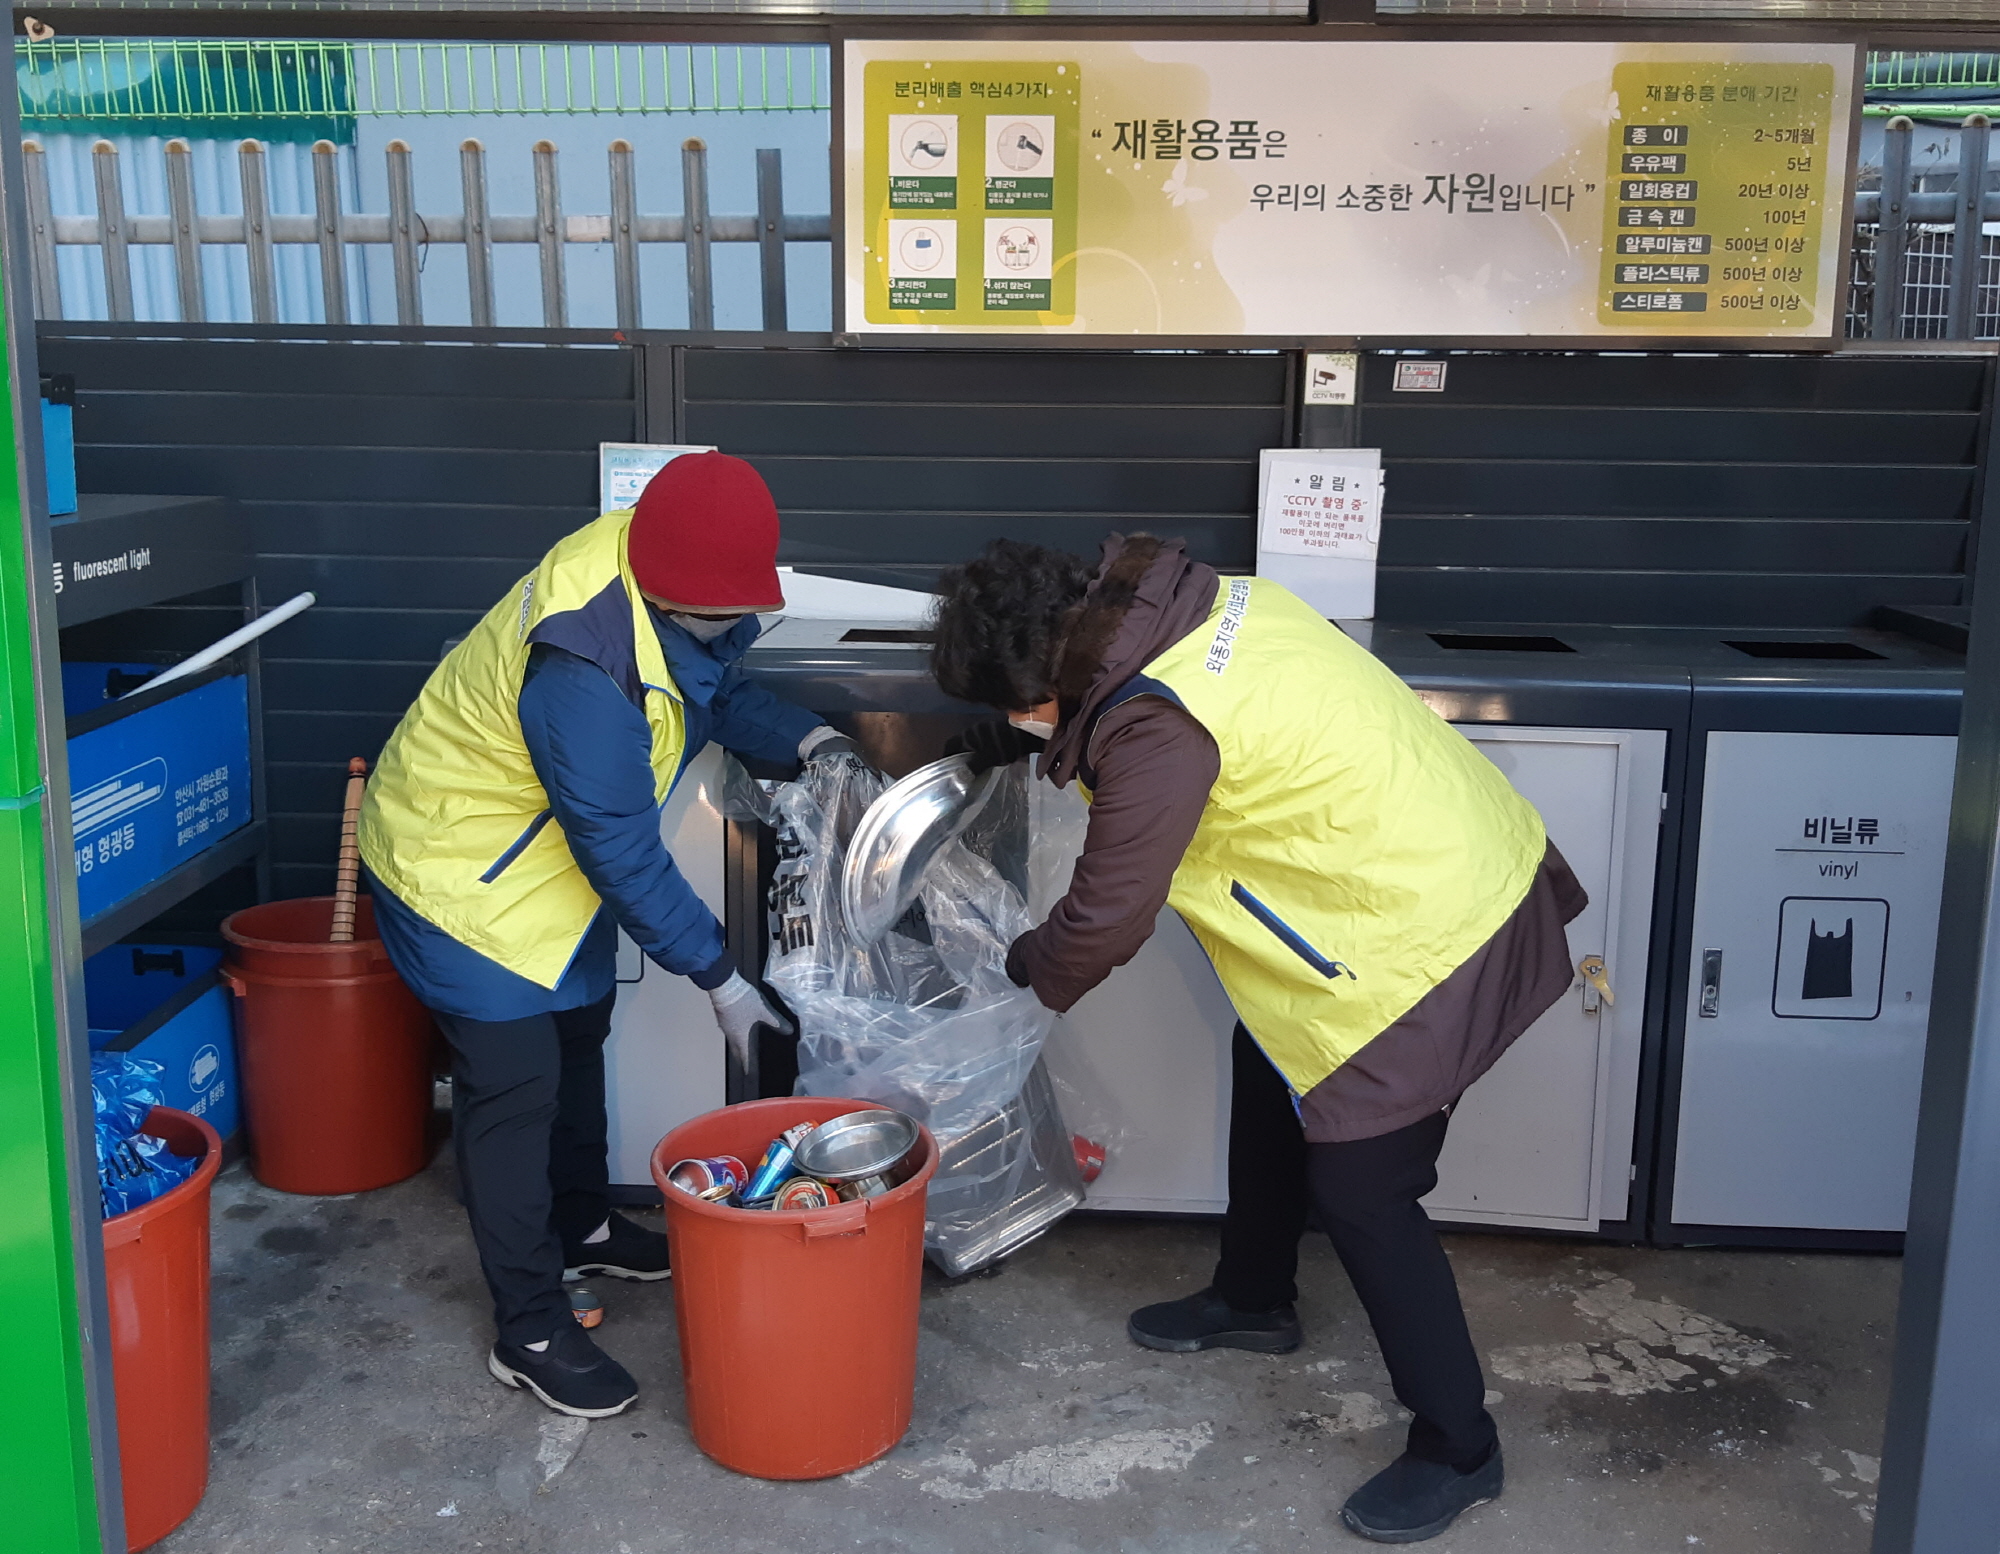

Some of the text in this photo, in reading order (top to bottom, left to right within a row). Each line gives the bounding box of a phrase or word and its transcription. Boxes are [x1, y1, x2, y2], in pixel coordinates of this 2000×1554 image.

[895, 81, 1047, 98] 분리배출 핵심4가지
[1646, 84, 1799, 102] 재활용품 분해 기간
[1754, 128, 1815, 144] 2~5개월
[1629, 155, 1677, 172] 우유팩
[1787, 156, 1812, 172] 5년
[1250, 183, 1325, 212] 우리의
[1335, 183, 1413, 212] 소중한
[1628, 182, 1691, 199] 일회용컵
[1738, 183, 1810, 199] 20년 이상
[1763, 210, 1806, 225] 100년
[1625, 237, 1703, 253] 알루미늄캔
[1724, 237, 1805, 253] 500년 이상
[1622, 266, 1700, 282] 플라스틱류
[1722, 266, 1803, 283] 500년 이상
[1620, 293, 1683, 310] 스티로폼
[1720, 294, 1801, 311] 500년 이상
[1321, 496, 1344, 509] 촬영
[73, 552, 128, 582] fluorescent
[129, 547, 151, 571] light
[175, 781, 195, 807] 안산시
[1804, 816, 1880, 845] 비닐류
[98, 822, 135, 864] 형광등
[1818, 860, 1859, 880] vinyl
